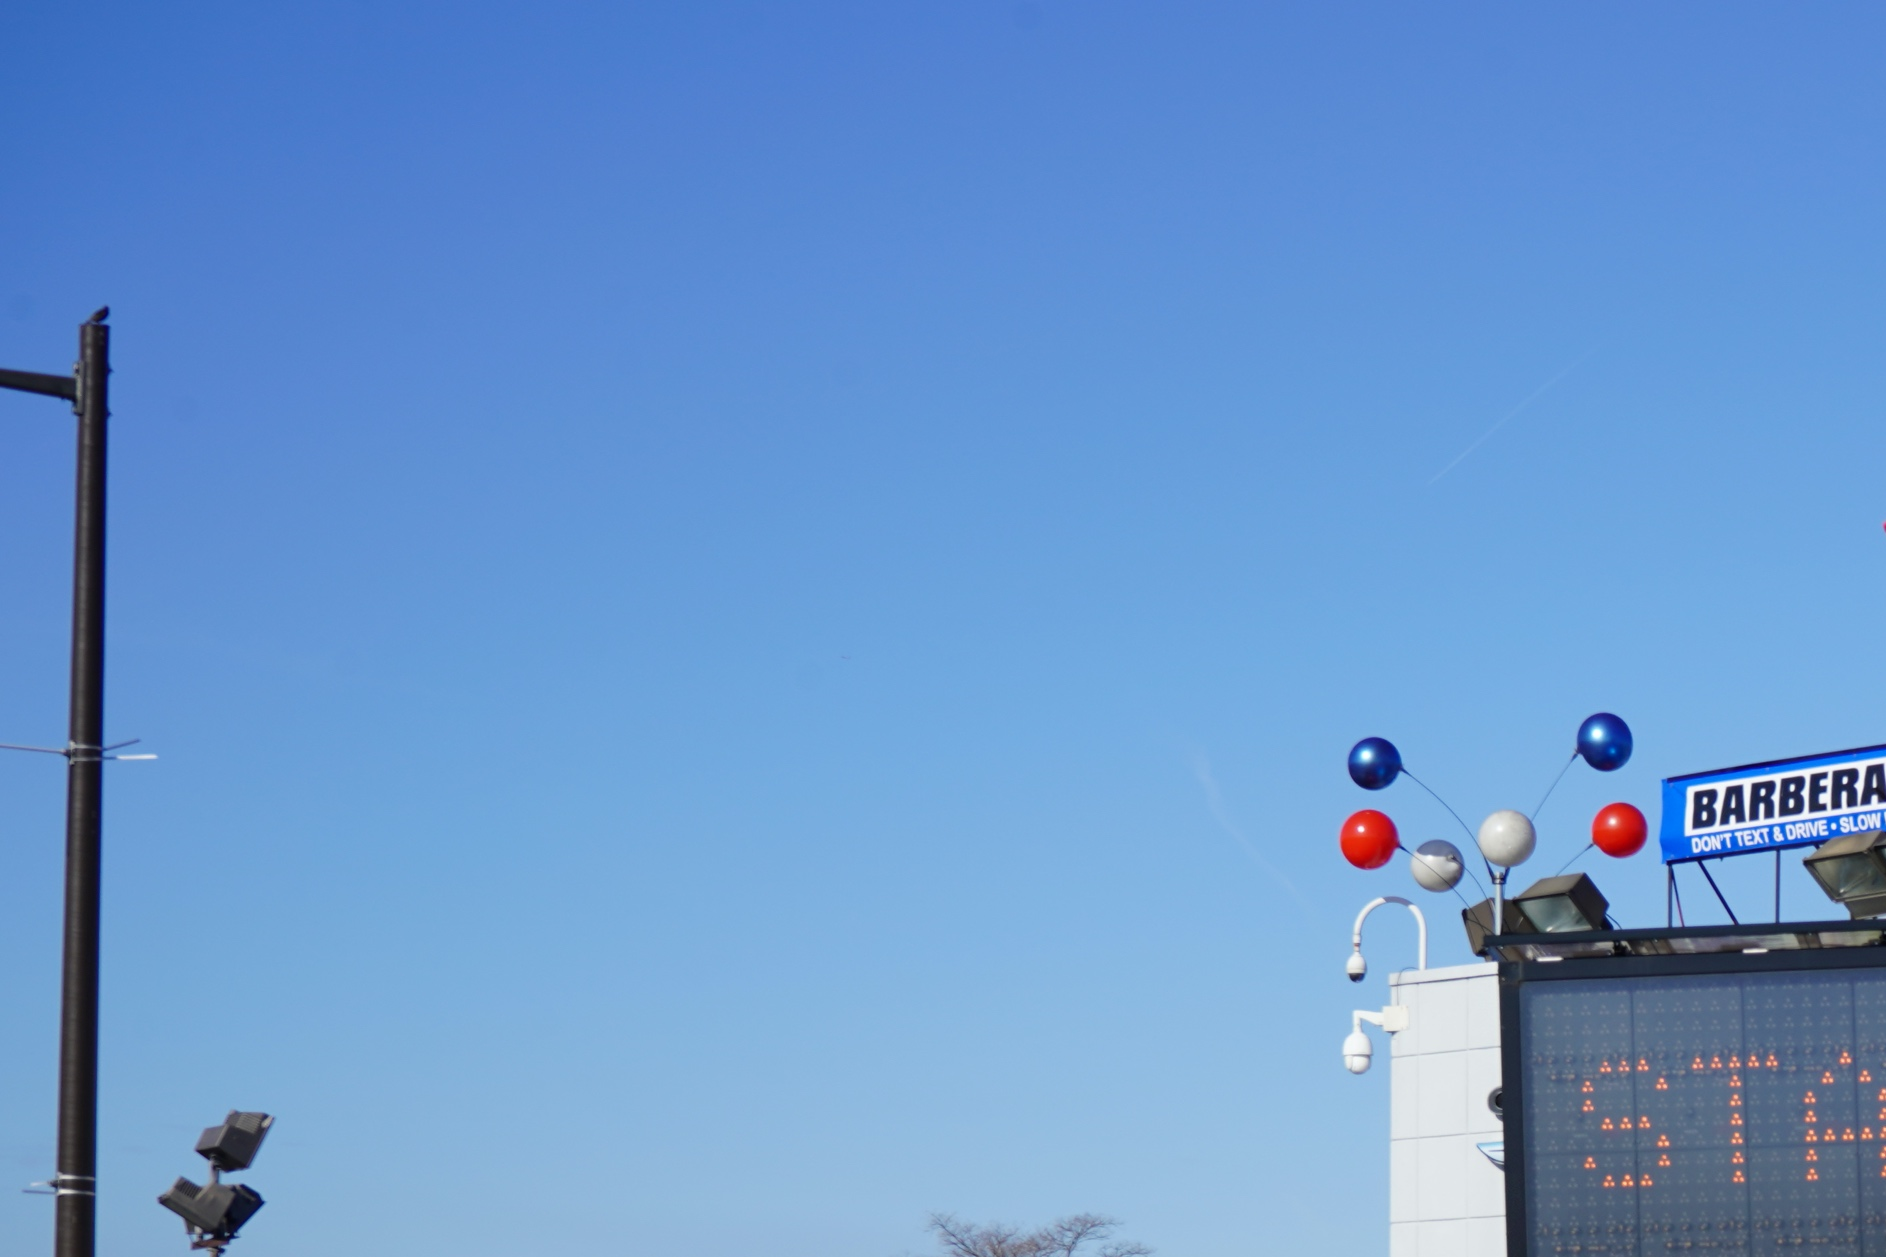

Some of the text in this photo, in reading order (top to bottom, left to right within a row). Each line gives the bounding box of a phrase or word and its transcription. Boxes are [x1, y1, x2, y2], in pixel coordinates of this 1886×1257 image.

[1691, 833, 1732, 854] DON'T
[1734, 826, 1770, 847] TEXT
[1773, 825, 1785, 842] &
[1785, 819, 1829, 841] DRIVE
[1839, 811, 1882, 833] SLOW
